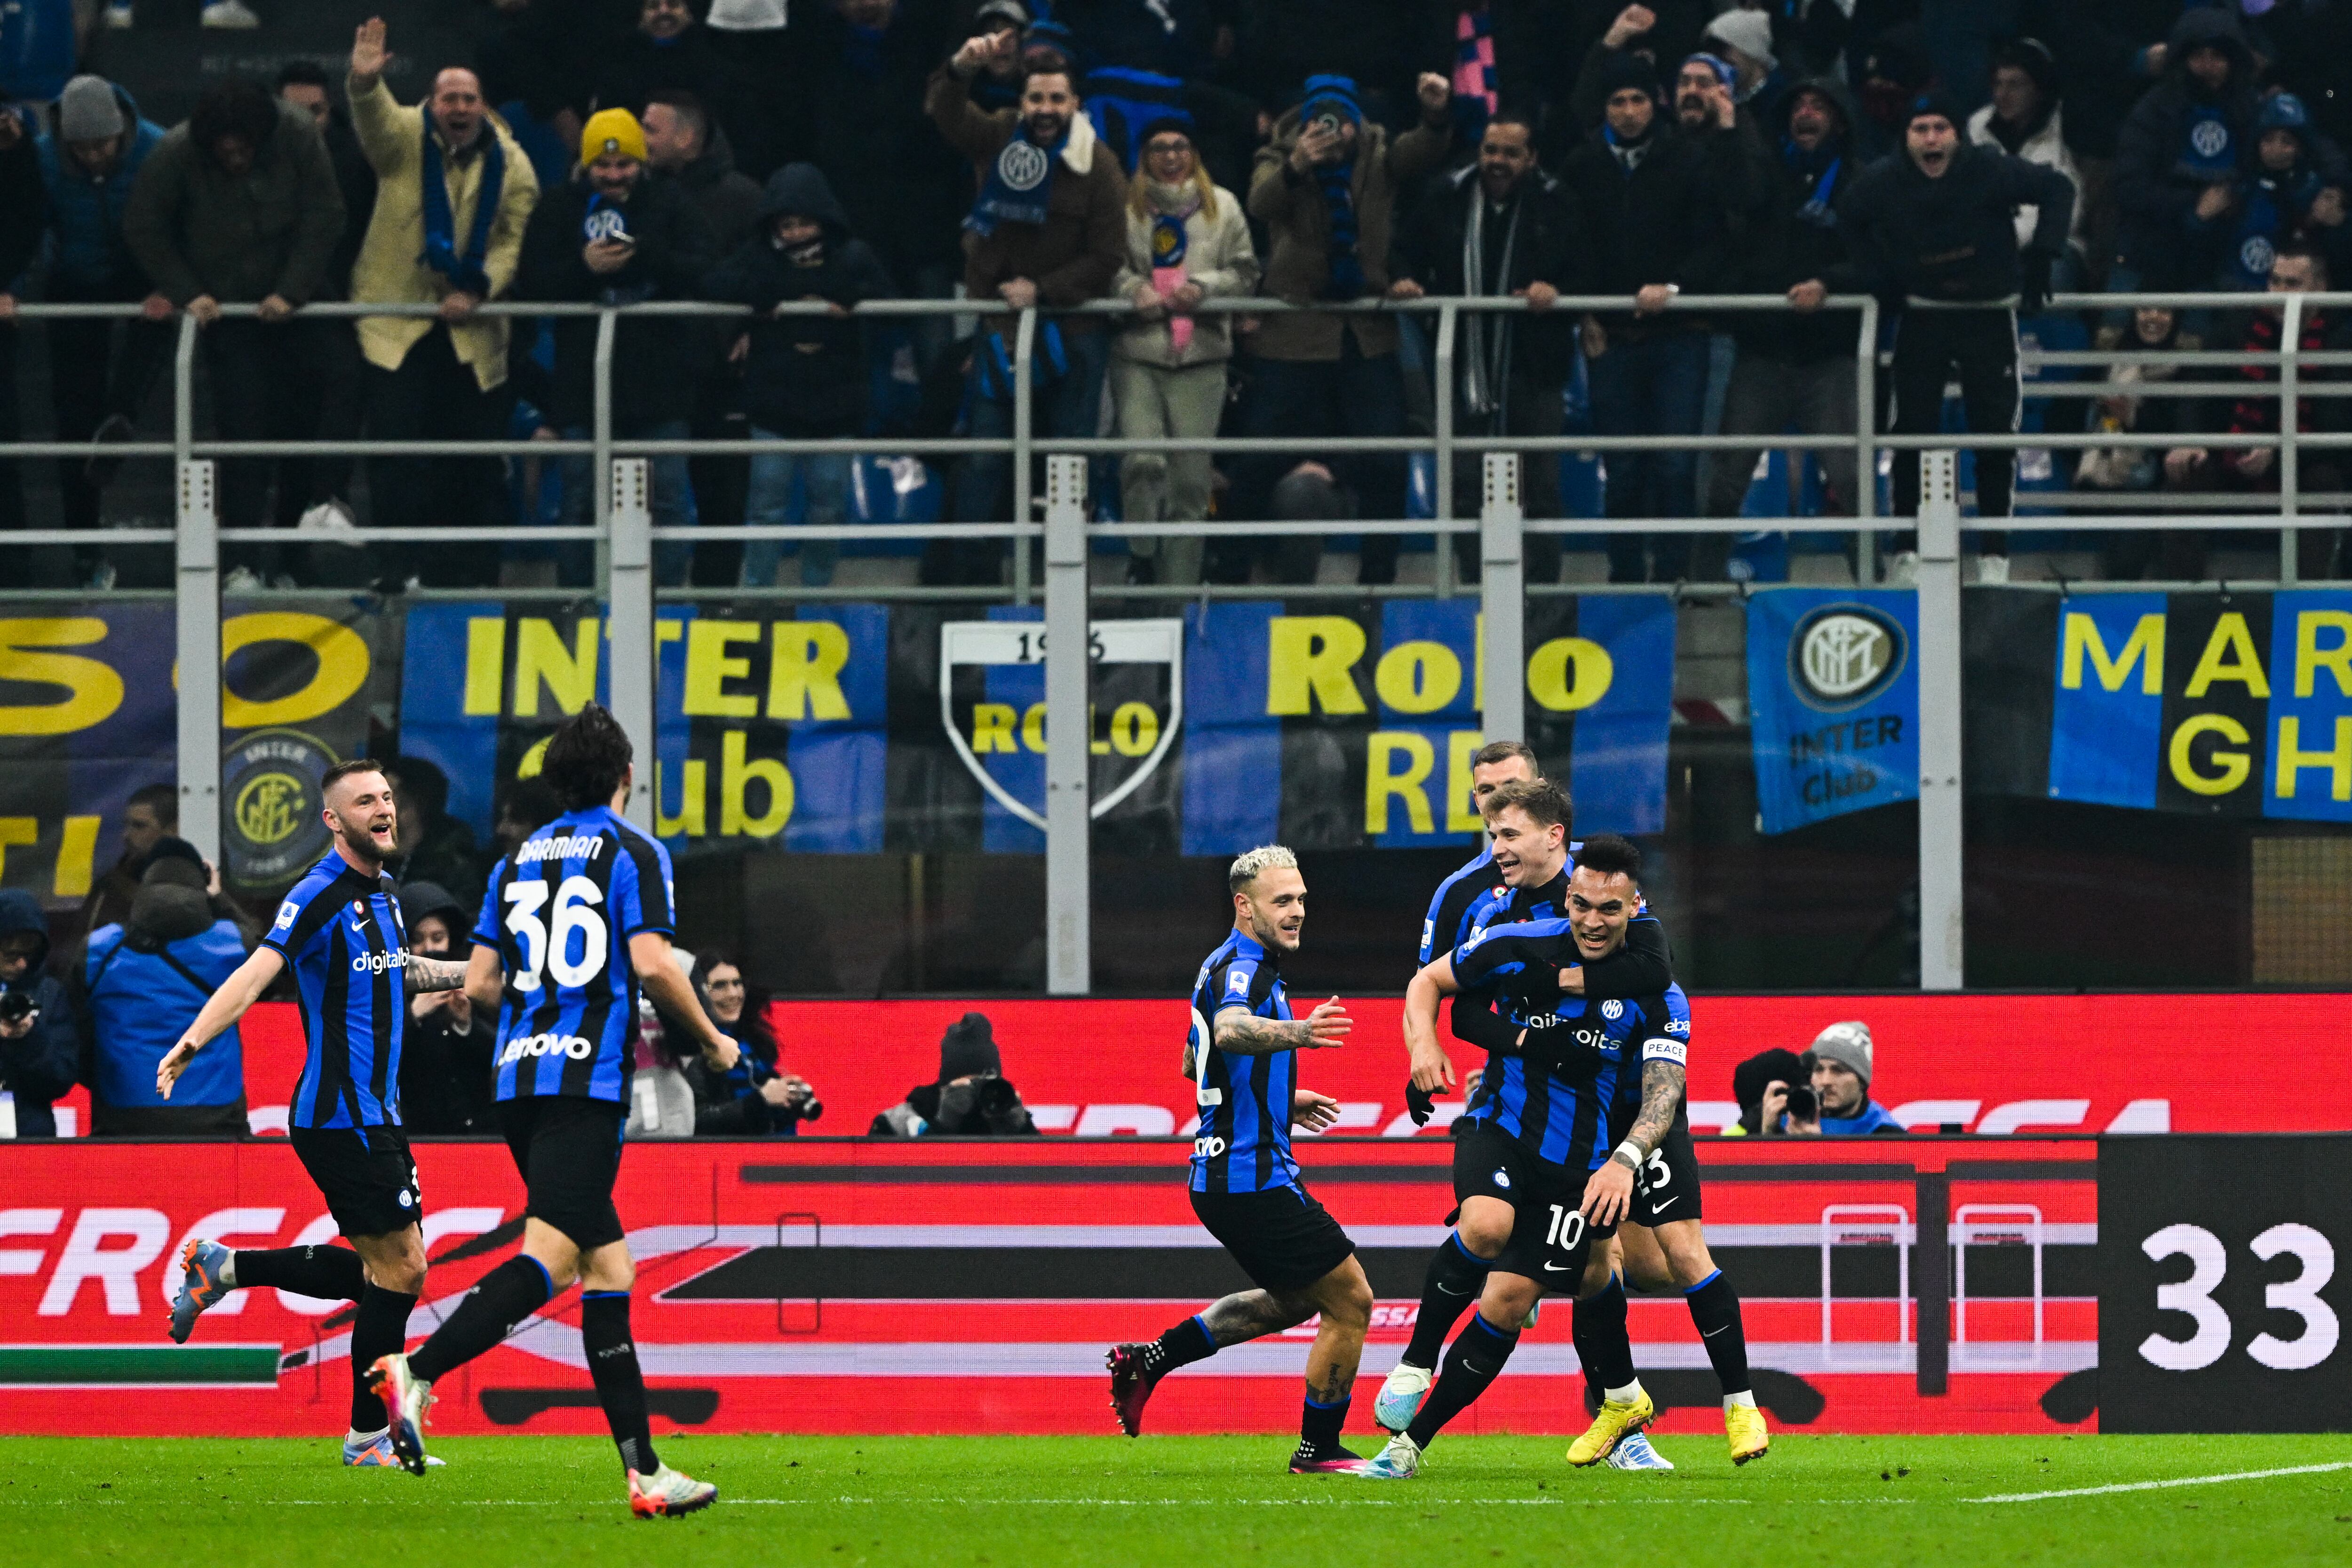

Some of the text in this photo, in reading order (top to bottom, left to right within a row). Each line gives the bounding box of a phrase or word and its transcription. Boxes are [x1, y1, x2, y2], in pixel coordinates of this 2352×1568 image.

[1018, 631, 1105, 662] 16
[1267, 615, 1613, 716] Roo
[1789, 714, 1904, 769] INTER
[1802, 766, 1878, 805] Club
[515, 836, 604, 865] DARMIAN
[503, 876, 608, 992] 36
[1648, 1043, 1684, 1057] PEACE
[1546, 1204, 1585, 1251] 10
[2138, 1223, 2340, 1371] 33
